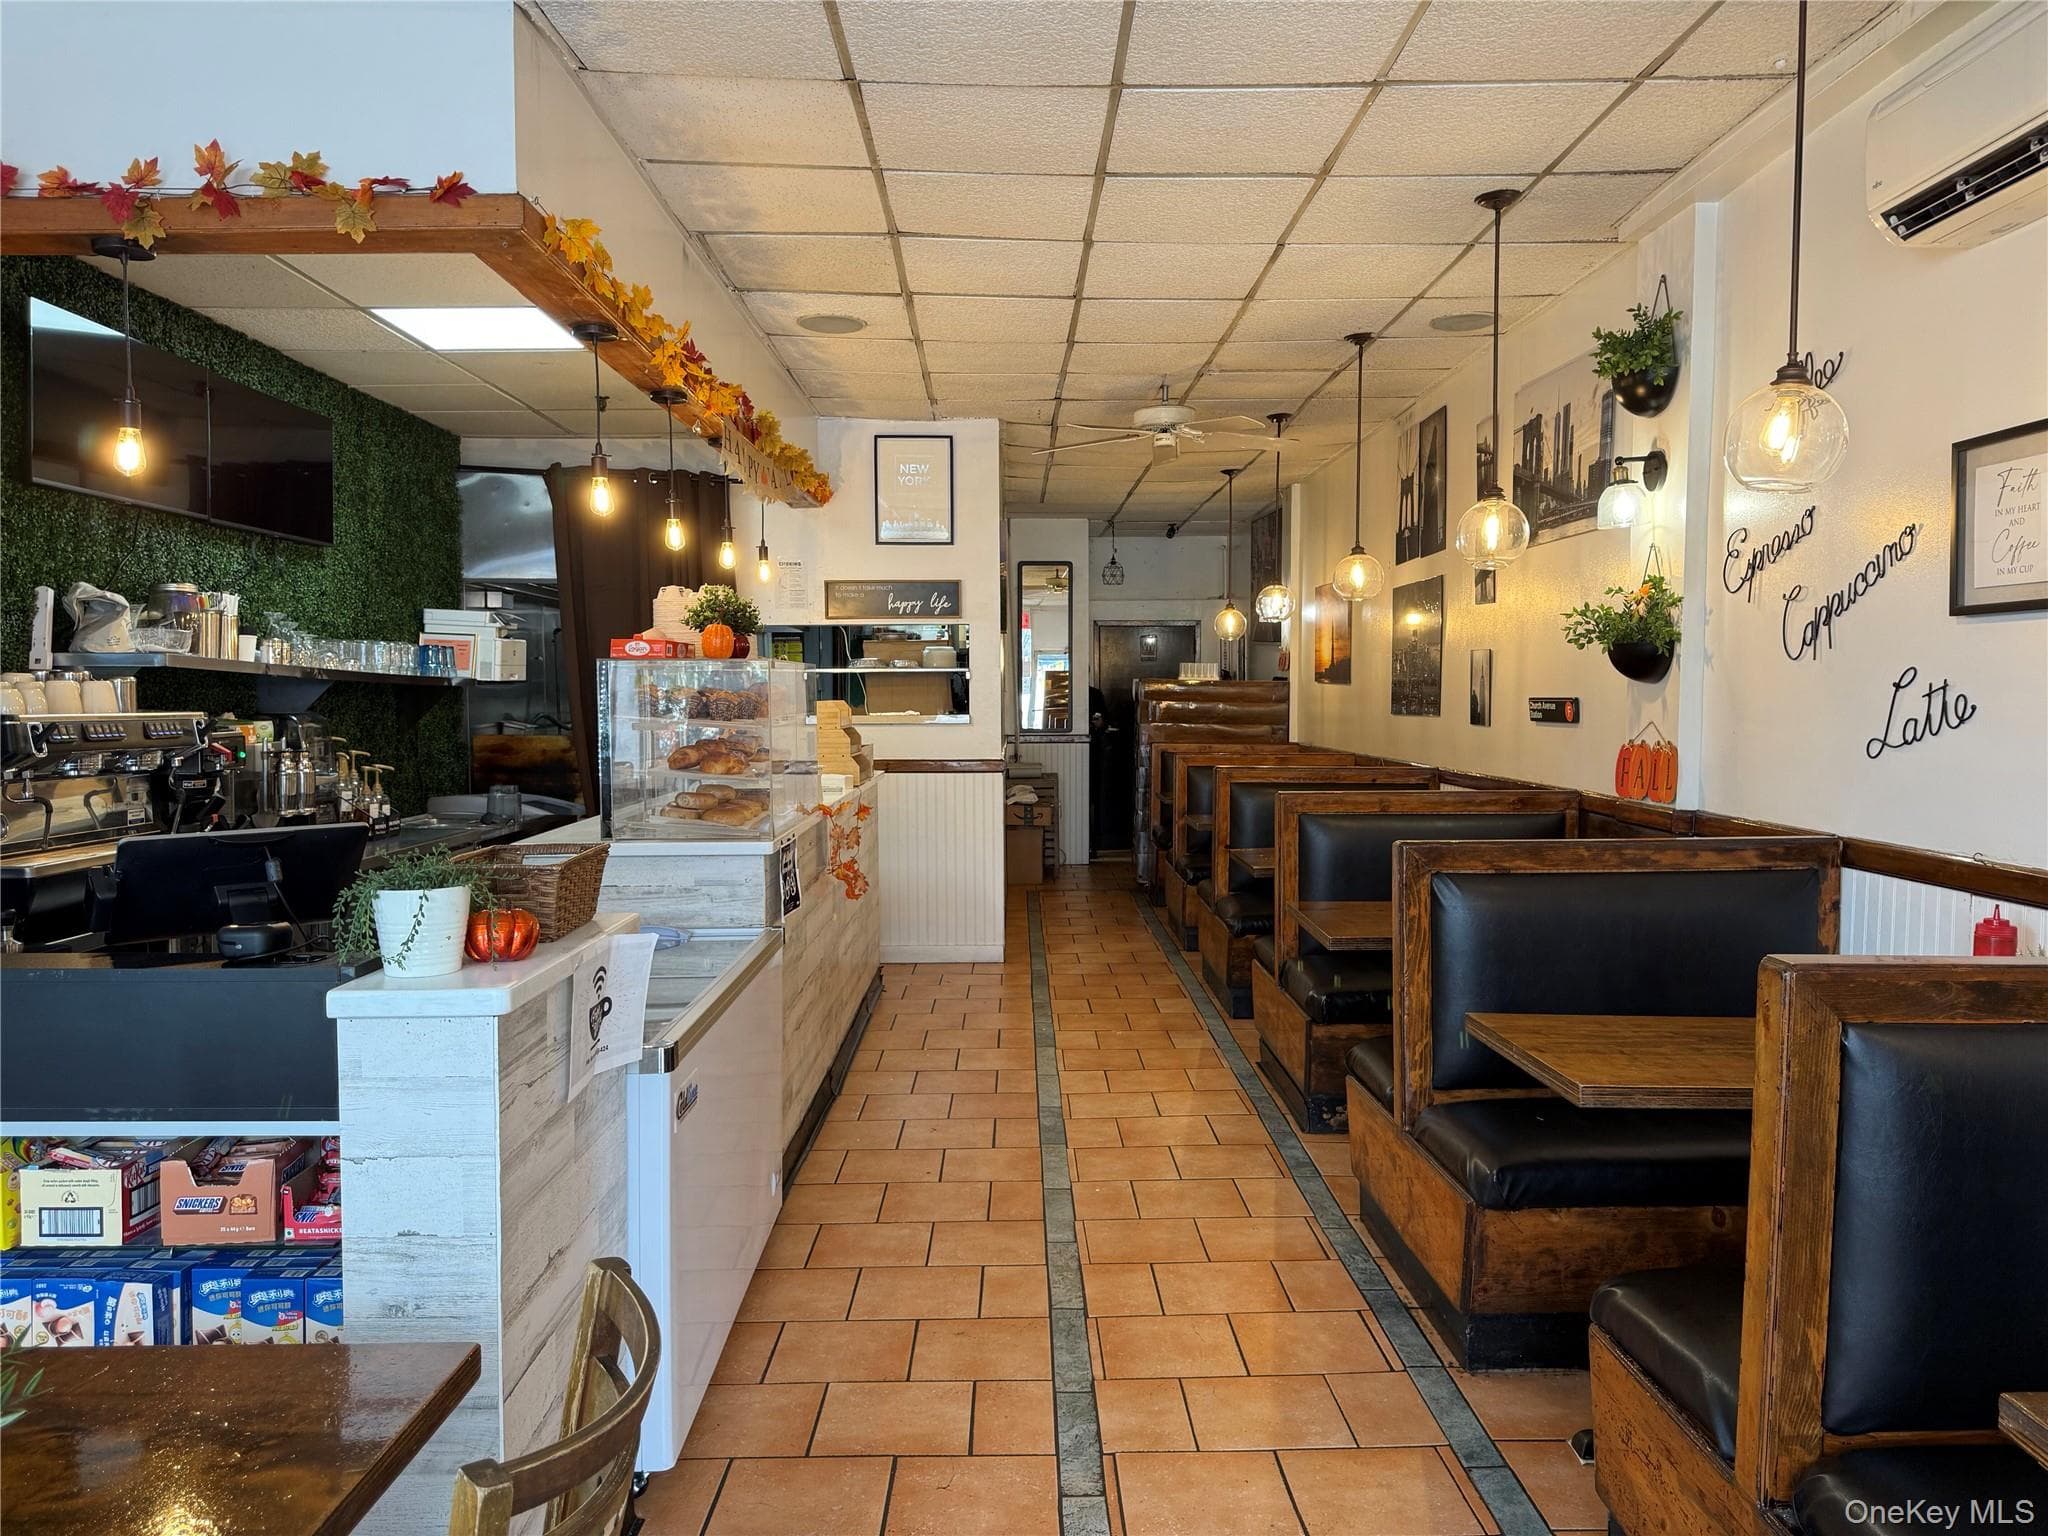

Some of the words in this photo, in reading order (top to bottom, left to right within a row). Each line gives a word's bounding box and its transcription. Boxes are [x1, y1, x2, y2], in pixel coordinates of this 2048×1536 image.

[900, 463, 929, 474] NEW
[1997, 467, 2041, 507] Faith
[1995, 508, 2003, 517] IN
[2005, 506, 2016, 515] MY
[2018, 502, 2040, 513] HEART
[2009, 517, 2026, 527] AND
[1992, 528, 2040, 566] Coffee
[1996, 567, 2005, 576] IN
[2007, 565, 2018, 575] MY
[2019, 564, 2034, 574] CUP
[887, 592, 924, 614] happy
[930, 592, 952, 615] life
[1782, 523, 1917, 662] Cappuccino
[1866, 666, 1977, 759] Latte
[1620, 758, 1672, 791] FALL
[176, 1197, 223, 1209] SNICKERS
